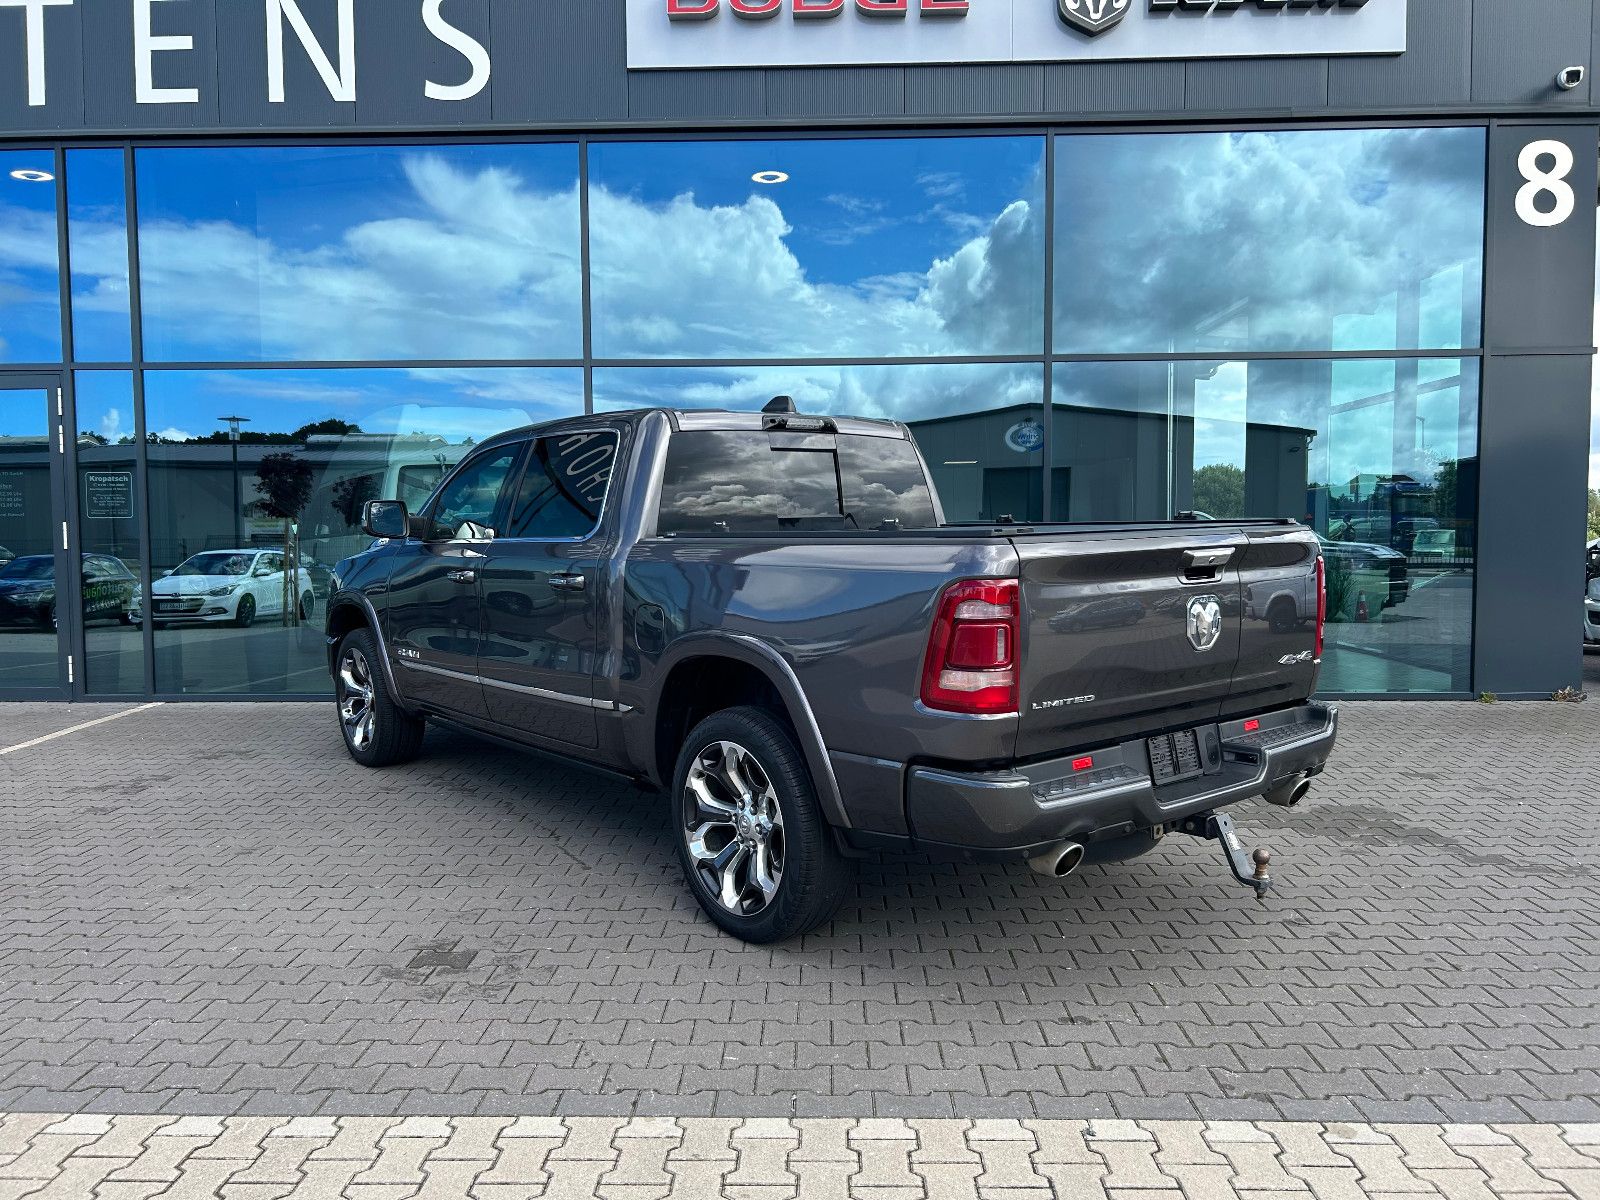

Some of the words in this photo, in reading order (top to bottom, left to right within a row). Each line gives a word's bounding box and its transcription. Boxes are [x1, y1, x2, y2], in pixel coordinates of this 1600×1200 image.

[0, 0, 491, 106] TENS
[1514, 139, 1575, 227] 8
[89, 475, 129, 483] Kropatsch
[1031, 694, 1096, 710] LIMITED
